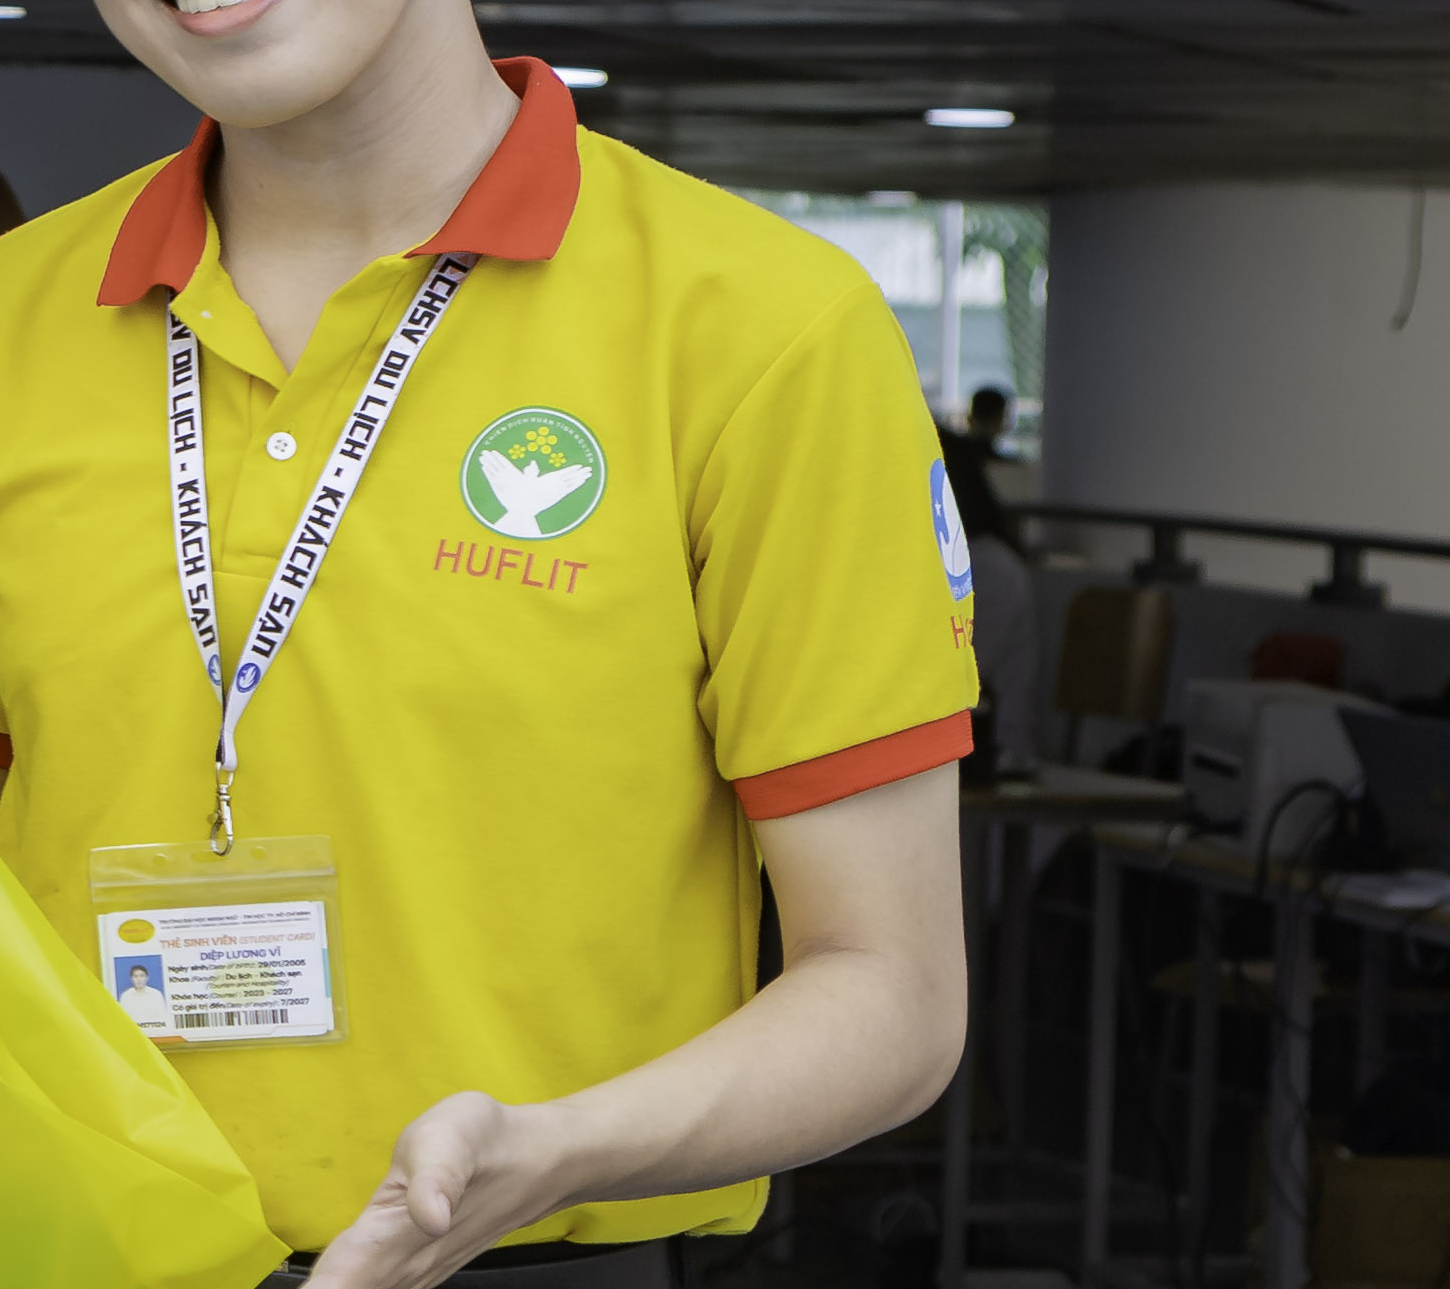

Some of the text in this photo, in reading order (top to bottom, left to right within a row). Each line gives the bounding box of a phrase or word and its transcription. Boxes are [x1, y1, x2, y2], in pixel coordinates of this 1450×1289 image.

[373, 350, 410, 390] DU
[170, 390, 197, 454] LỊCH
[339, 395, 388, 461] LỊCH
[177, 478, 207, 577] KHÁCH
[280, 485, 346, 589] KHÁCH
[433, 539, 589, 594] HUFLIT
[187, 583, 217, 648] SẠN
[251, 592, 296, 658] SẠN
